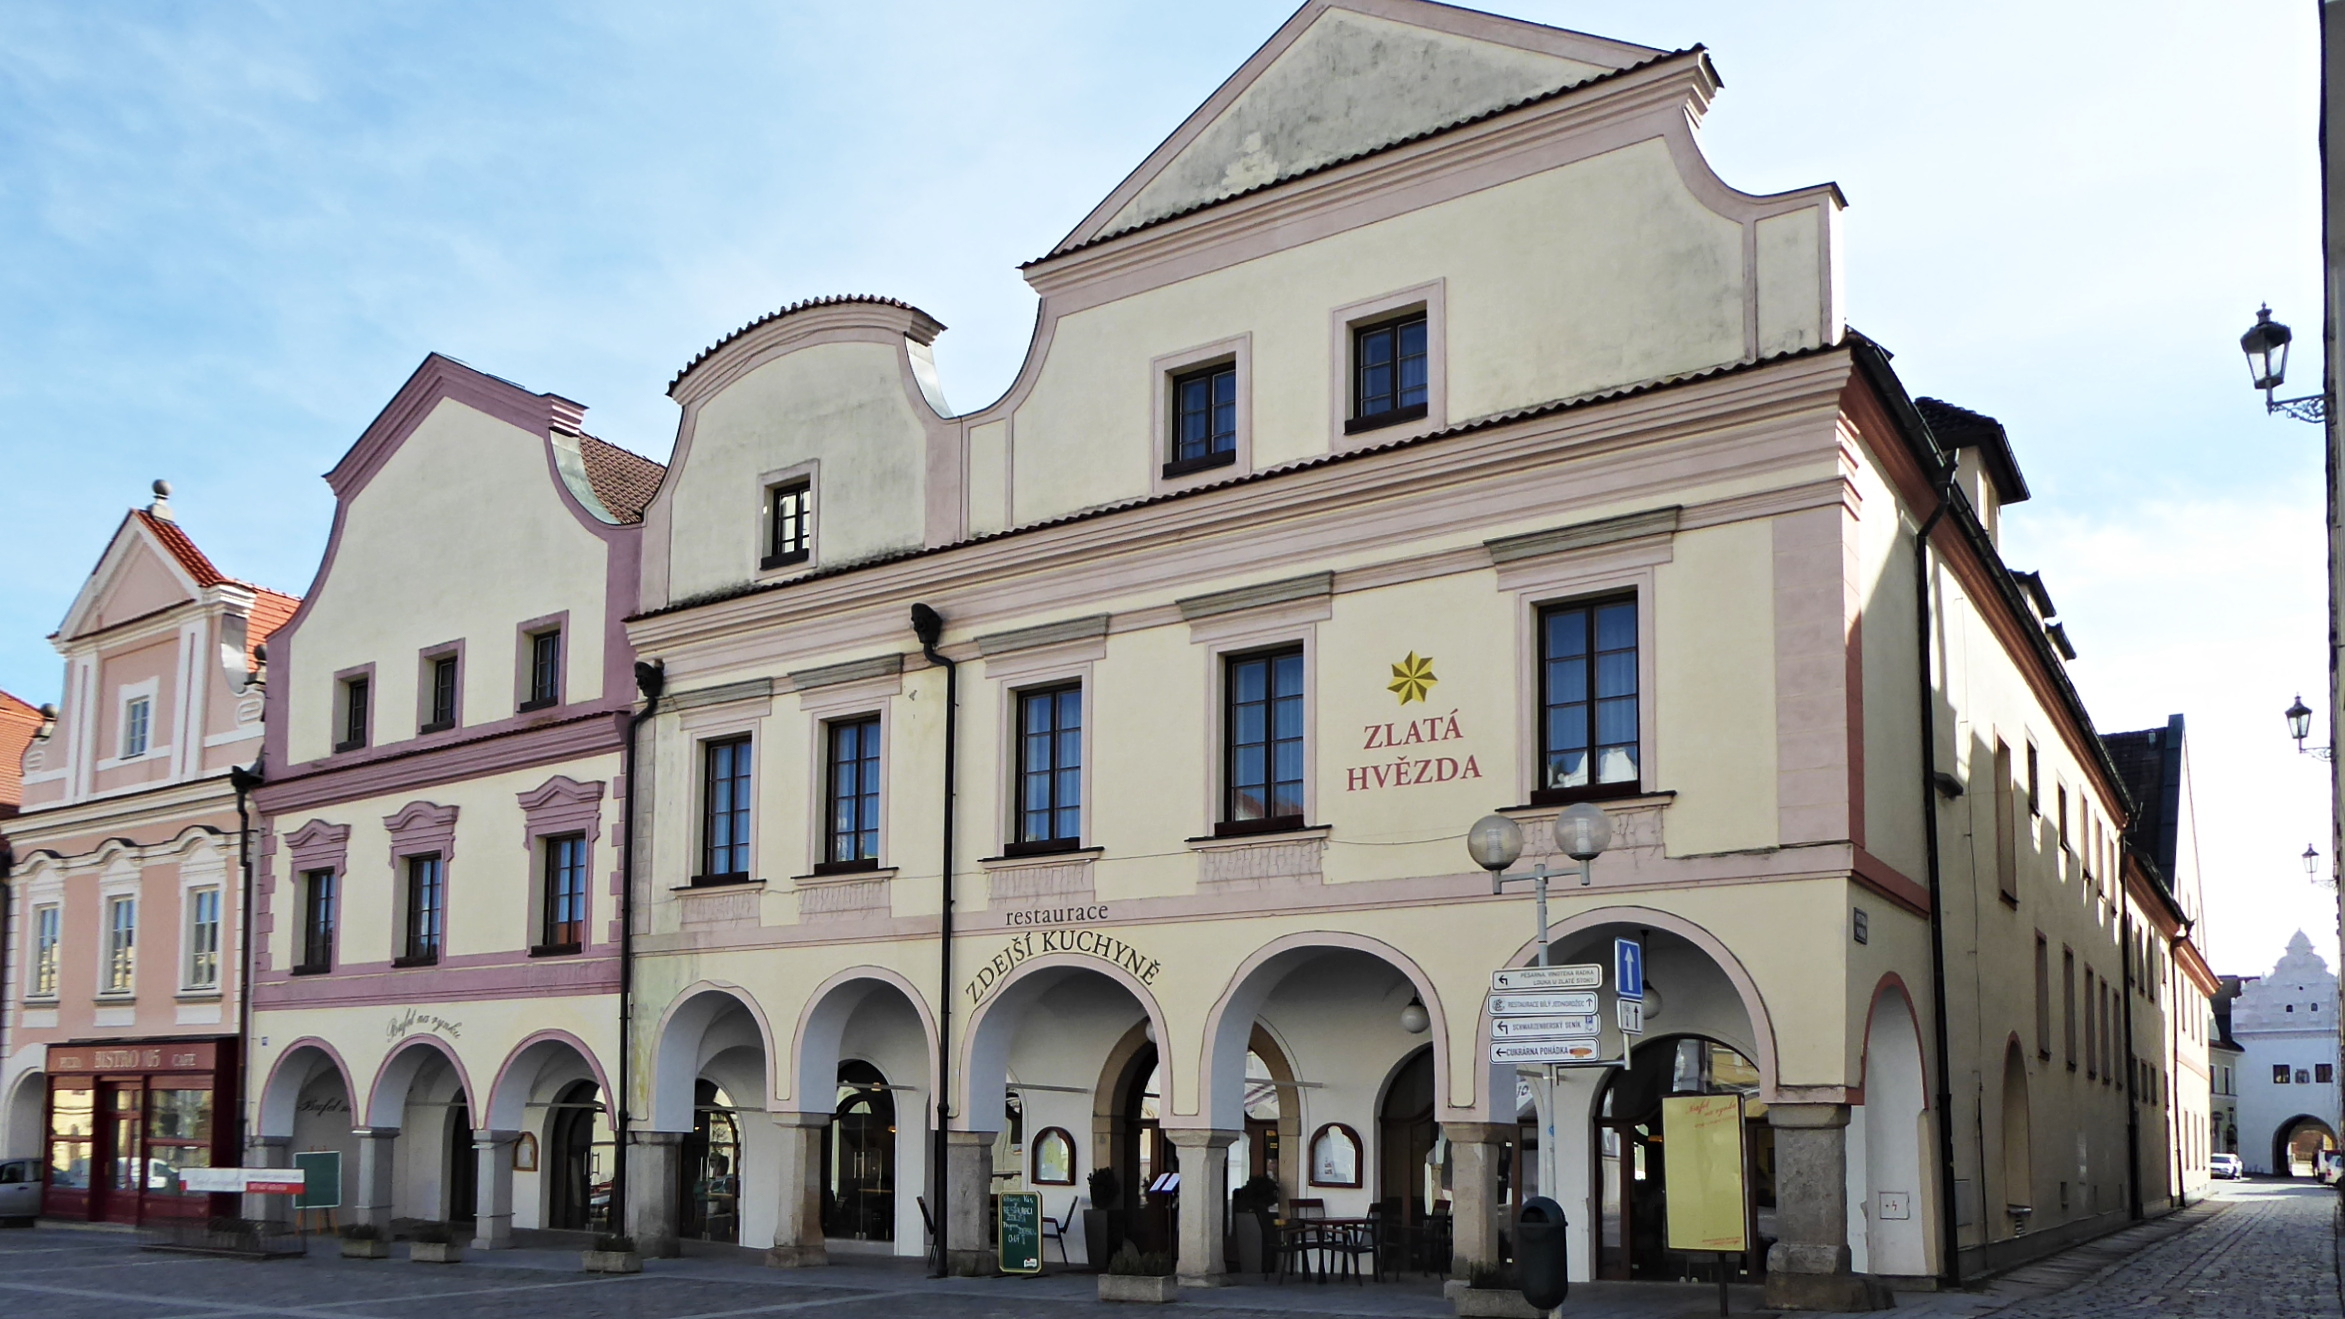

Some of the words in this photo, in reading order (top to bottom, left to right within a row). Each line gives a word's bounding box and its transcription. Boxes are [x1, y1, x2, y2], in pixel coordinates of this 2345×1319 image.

[1362, 708, 1464, 750] ZLATÁ
[1346, 754, 1483, 792] HVĚZDA
[1006, 905, 1109, 926] restaurace
[965, 932, 1034, 1005] ZDEJŠÍ
[1041, 930, 1162, 986] KUCHYNĚ
[94, 1050, 139, 1068] BISTRO
[1506, 1045, 1539, 1056] CUKRÁRNA
[1540, 1044, 1568, 1055] POHÁDKA
